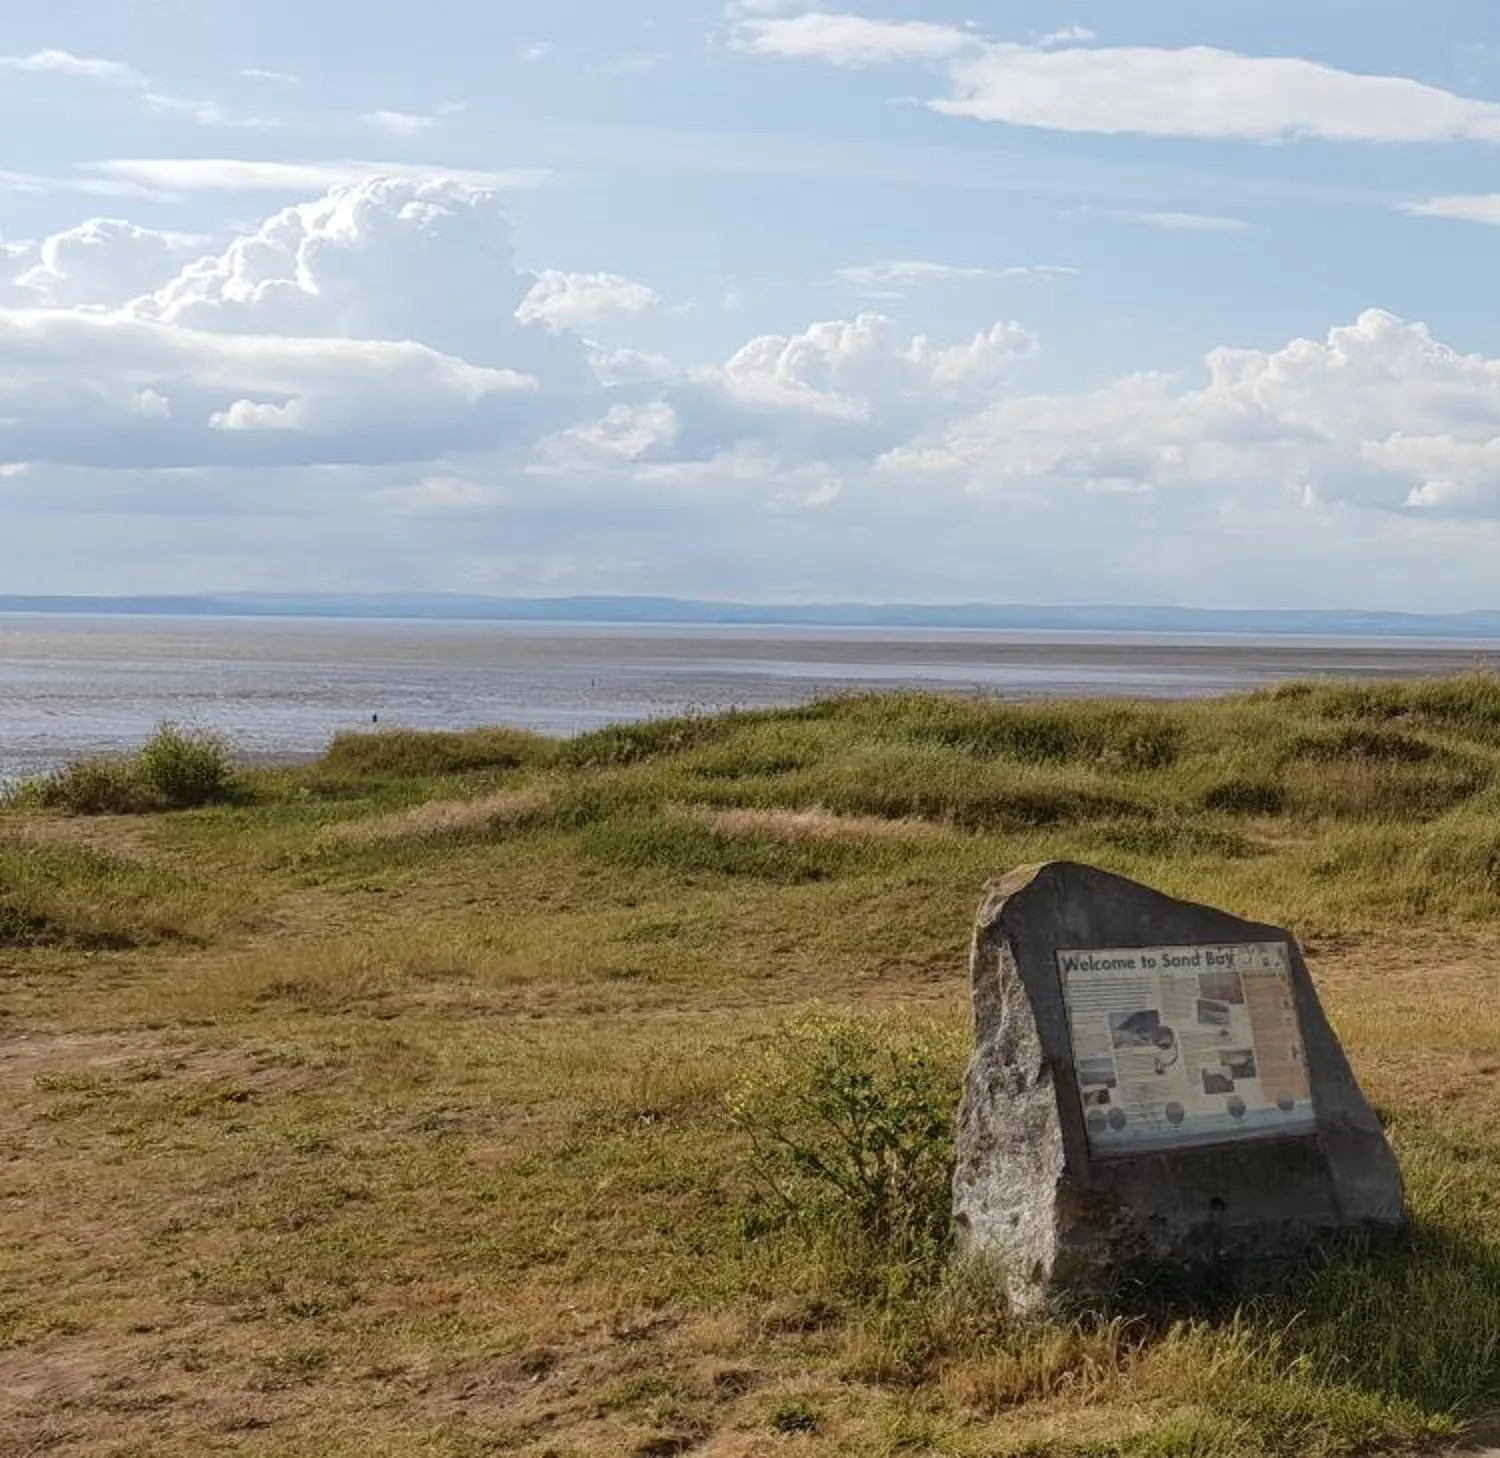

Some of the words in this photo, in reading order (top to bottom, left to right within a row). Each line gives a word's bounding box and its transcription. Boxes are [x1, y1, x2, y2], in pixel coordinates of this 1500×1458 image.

[1062, 955, 1136, 971] Welcome
[1141, 955, 1157, 969] to
[1162, 951, 1200, 967] Sand
[1205, 951, 1235, 968] Bay
